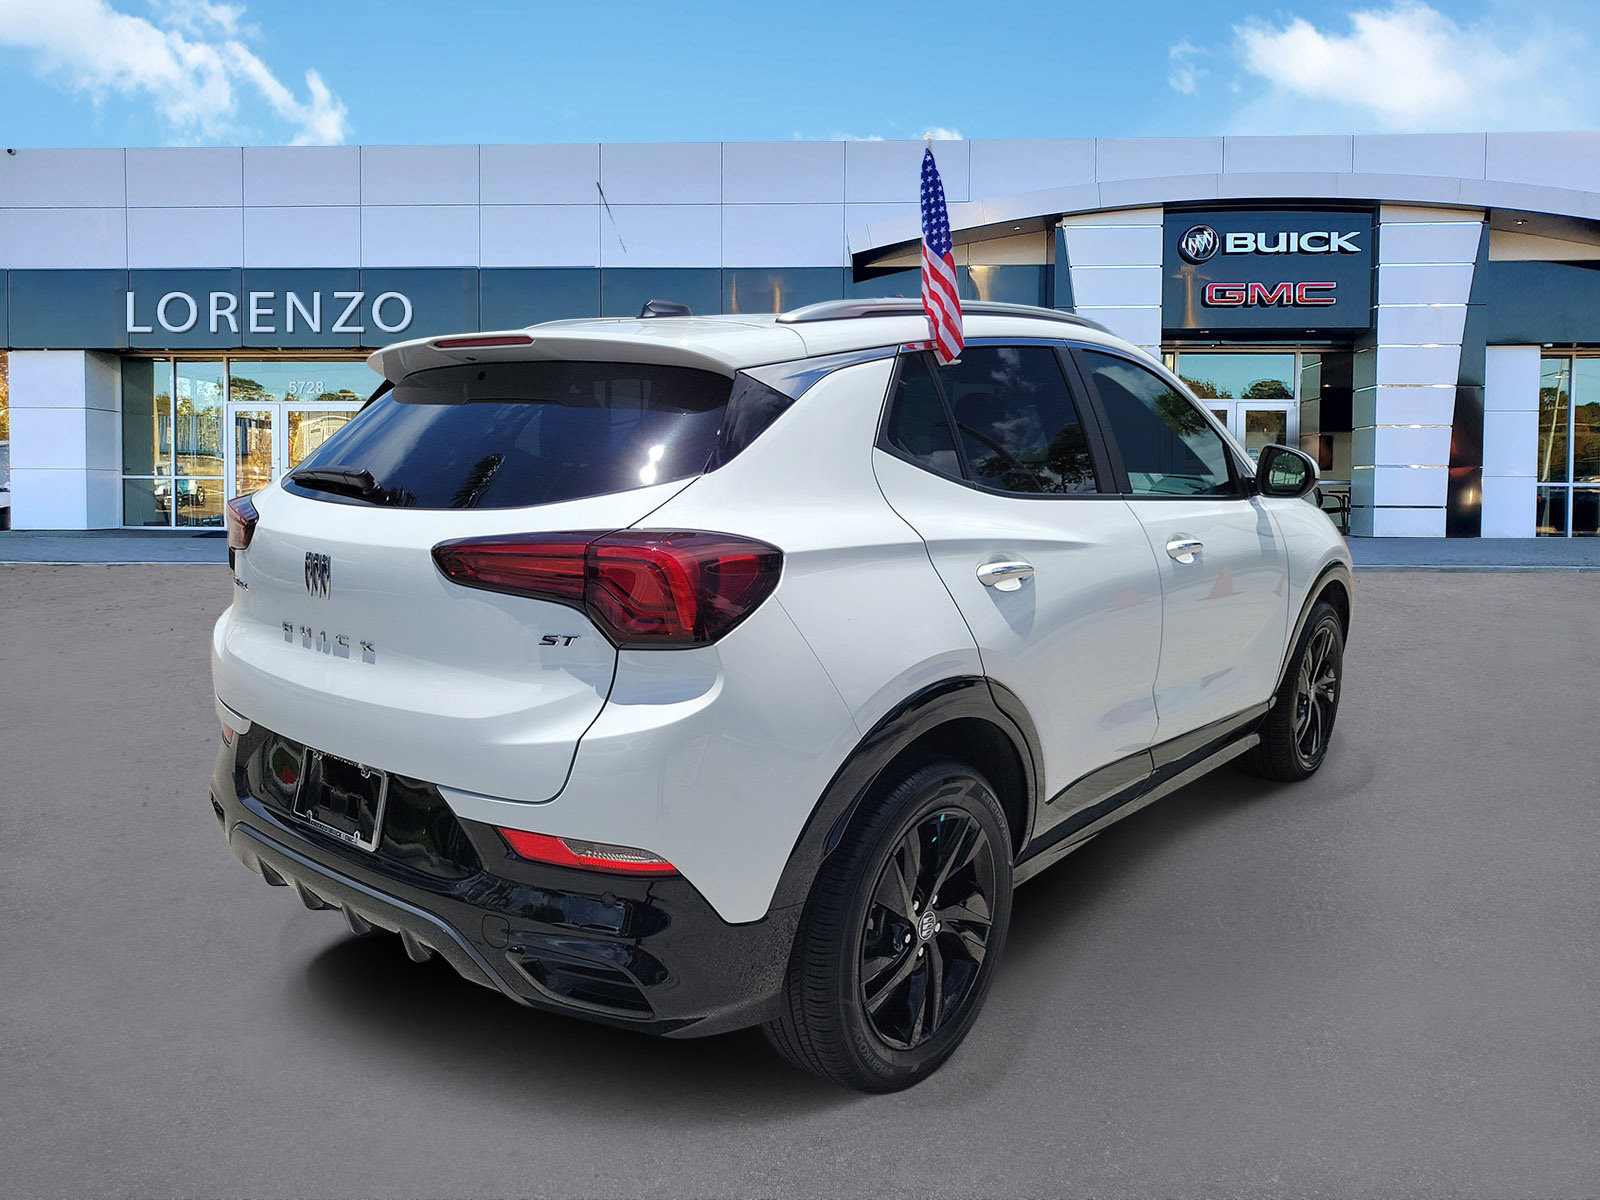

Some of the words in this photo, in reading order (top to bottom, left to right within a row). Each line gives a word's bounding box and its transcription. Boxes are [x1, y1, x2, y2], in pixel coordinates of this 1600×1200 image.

[1225, 231, 1362, 253] BUICK
[1207, 282, 1338, 305] GMC
[126, 291, 413, 333] LORENZO
[288, 380, 325, 394] 5728
[281, 621, 377, 655] BUICK
[538, 634, 582, 648] ST
